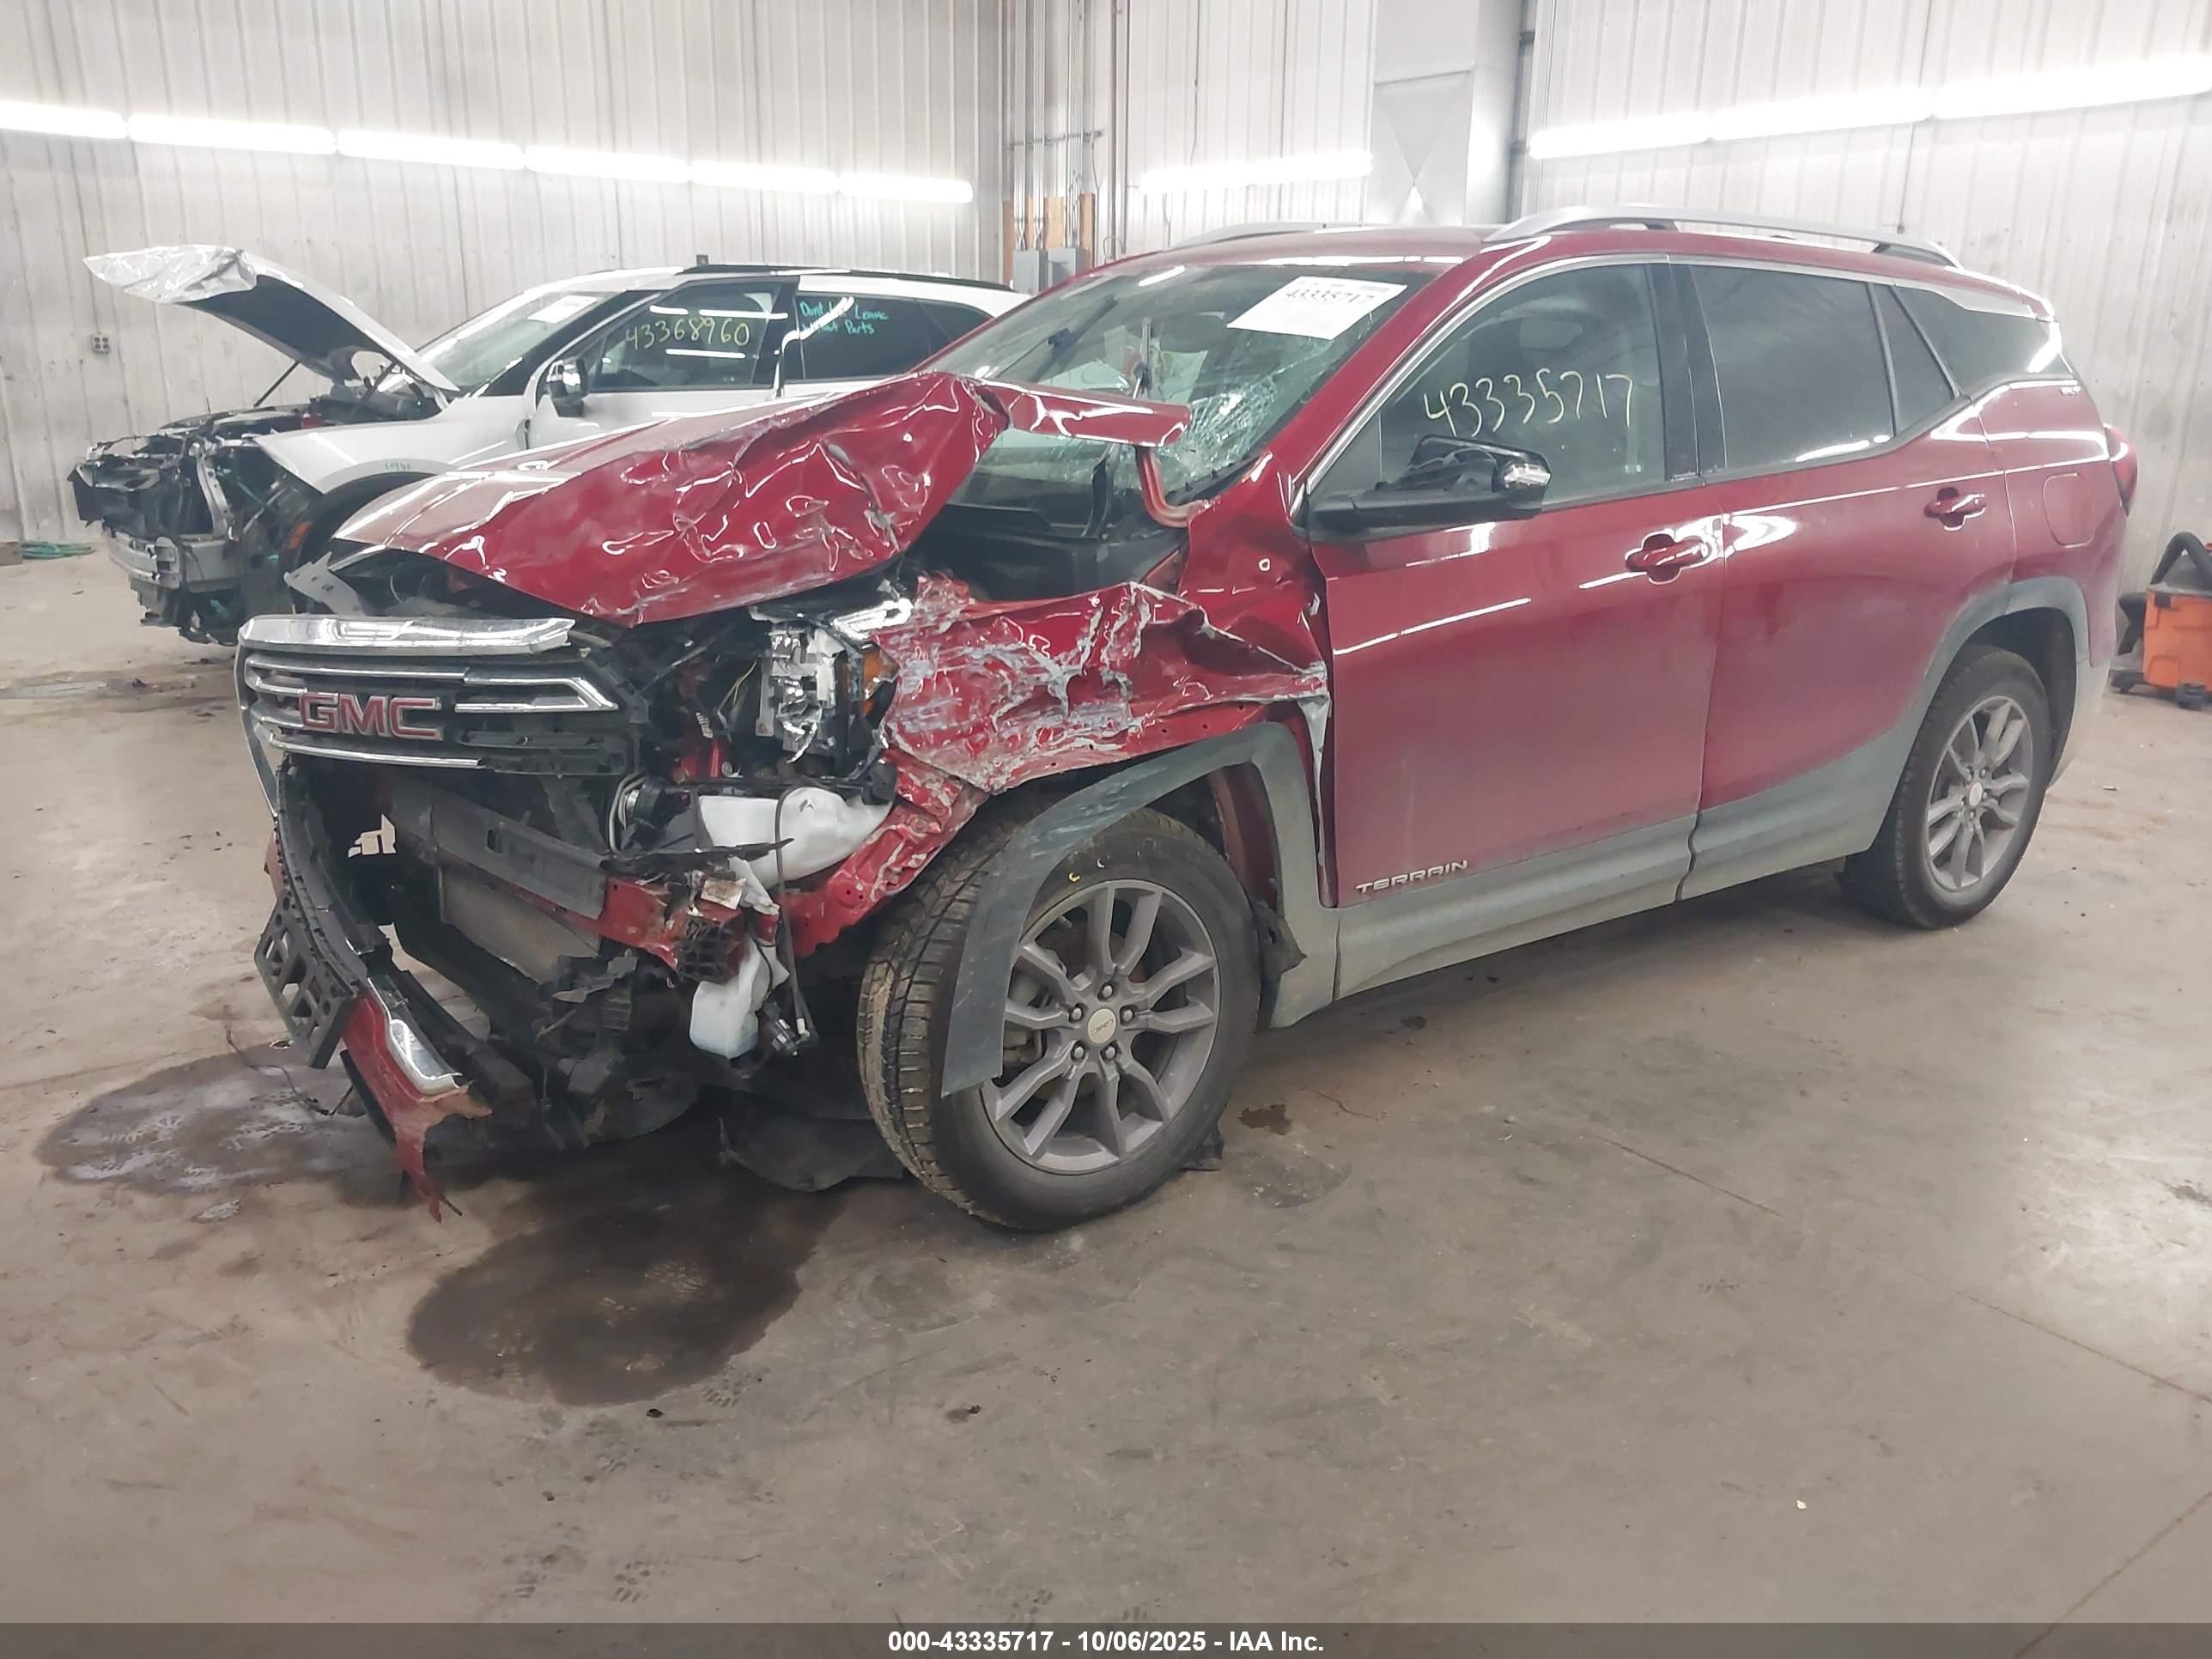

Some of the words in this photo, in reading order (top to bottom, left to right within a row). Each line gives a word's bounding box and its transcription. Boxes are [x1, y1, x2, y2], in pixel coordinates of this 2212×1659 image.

[625, 317, 750, 351] 43368960
[1424, 368, 1633, 438] 43335717
[298, 691, 444, 741] GMC
[1355, 860, 1468, 894] TERRAIN
